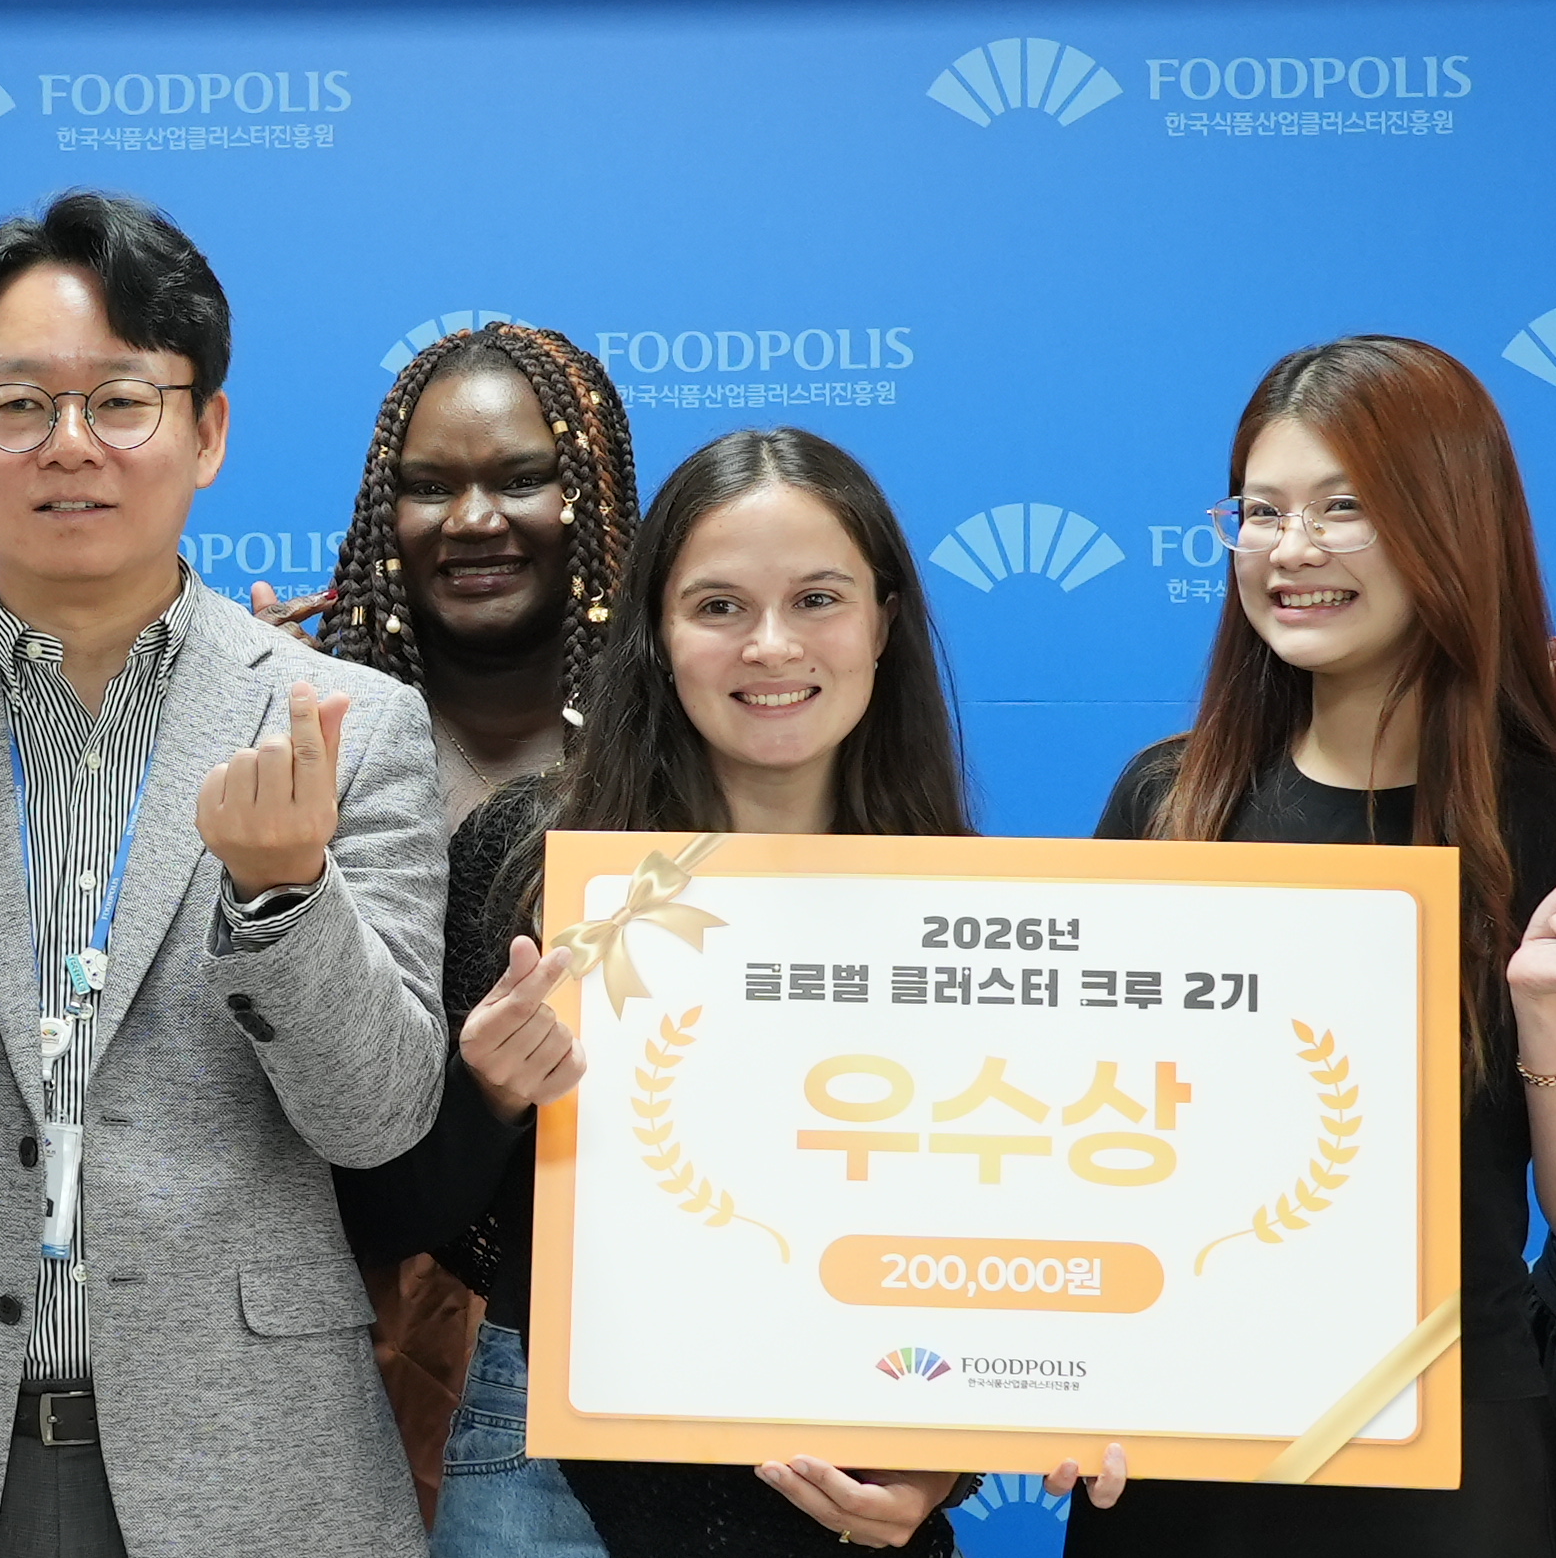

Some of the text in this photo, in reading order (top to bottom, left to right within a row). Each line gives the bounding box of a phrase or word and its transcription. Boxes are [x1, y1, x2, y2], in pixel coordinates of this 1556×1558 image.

[39, 71, 351, 115] FOODPOLIS
[1145, 56, 1471, 100] FOODPOLIS
[57, 124, 334, 150] 한국식품산업클러스터진흥원
[1165, 110, 1453, 136] 한국식품산업클러스터진흥원
[595, 327, 913, 373] FOODPOLIS
[621, 381, 896, 408] 한국식품산업클러스터진흥원
[922, 916, 1079, 951] 2026년
[746, 963, 1257, 1012] 글로벌 클러스터 크루 2기
[797, 1055, 1192, 1186] 우수상
[881, 1253, 1101, 1298] 200,000원
[961, 1357, 1087, 1378] FOODPOLIS
[968, 1378, 1080, 1392] 한국식품산업클러스터진흥원
